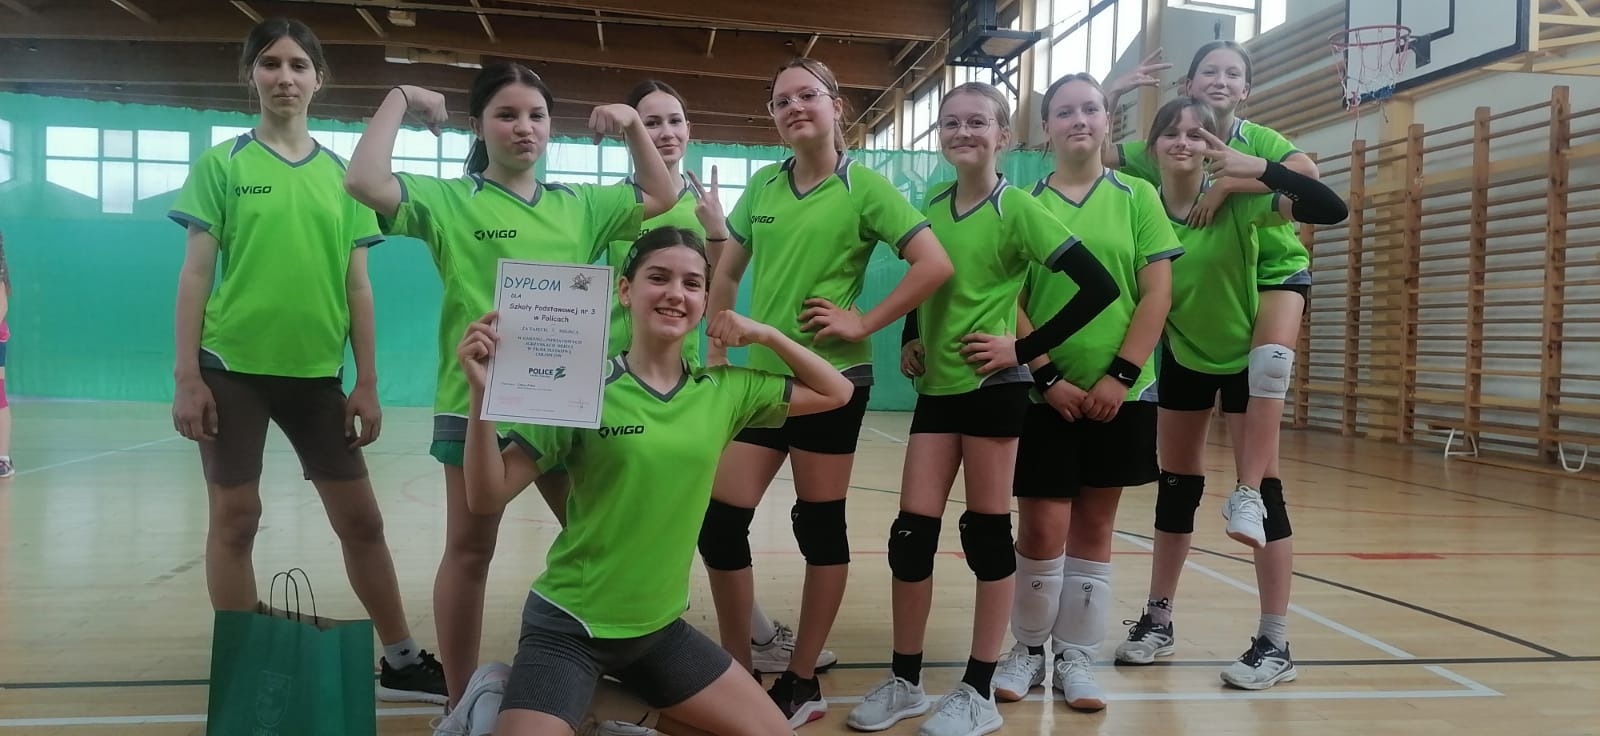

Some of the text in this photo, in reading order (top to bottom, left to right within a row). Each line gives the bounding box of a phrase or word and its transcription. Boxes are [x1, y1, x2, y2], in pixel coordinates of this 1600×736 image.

[503, 276, 561, 292] DYPLOM
[509, 303, 532, 312] Szkoły
[534, 304, 578, 316] Podstawowej
[541, 314, 569, 323] Policach
[528, 367, 554, 376] POLICE
